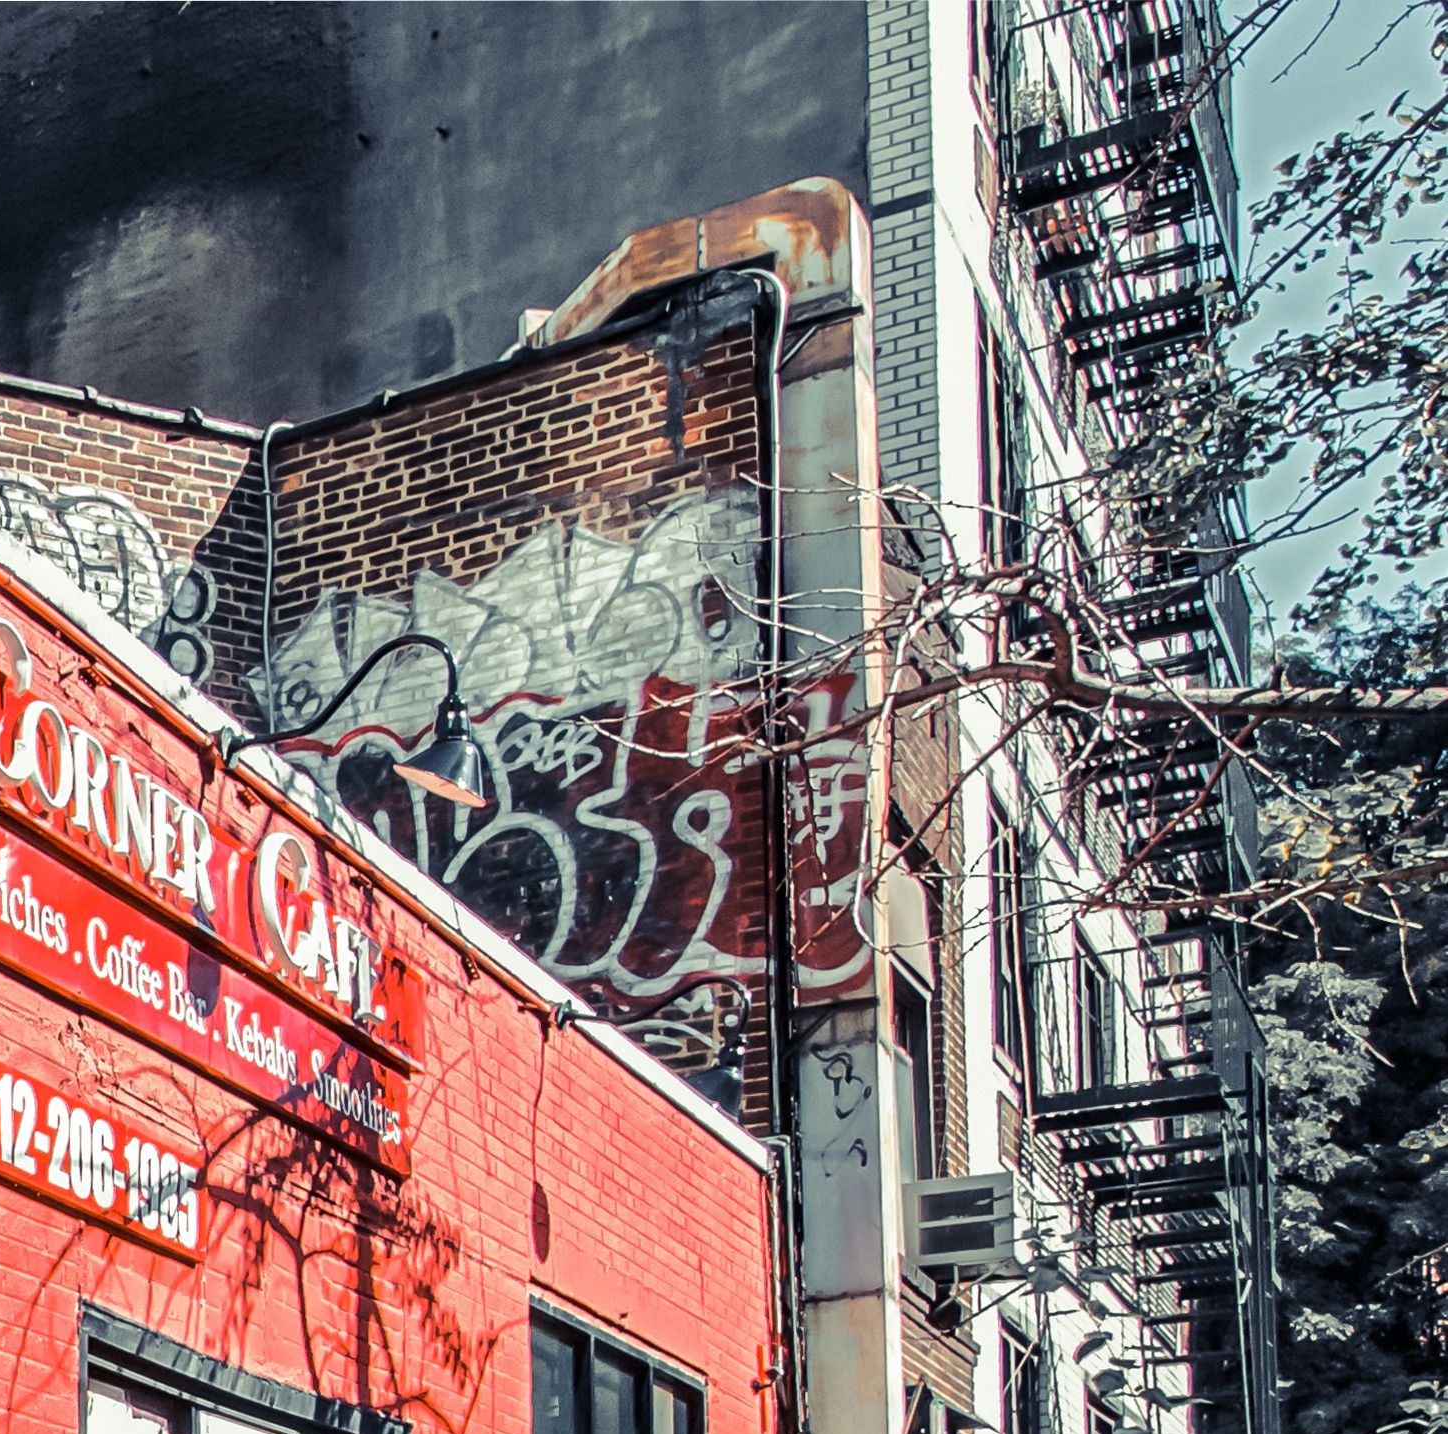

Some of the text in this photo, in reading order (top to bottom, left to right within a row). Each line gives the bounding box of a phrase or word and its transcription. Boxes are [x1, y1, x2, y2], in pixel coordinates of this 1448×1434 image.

[85, 917, 164, 1010] Coffee
[167, 960, 207, 1035] Bar
[223, 995, 298, 1086] Kebabs
[311, 1048, 401, 1145] Smoothies
